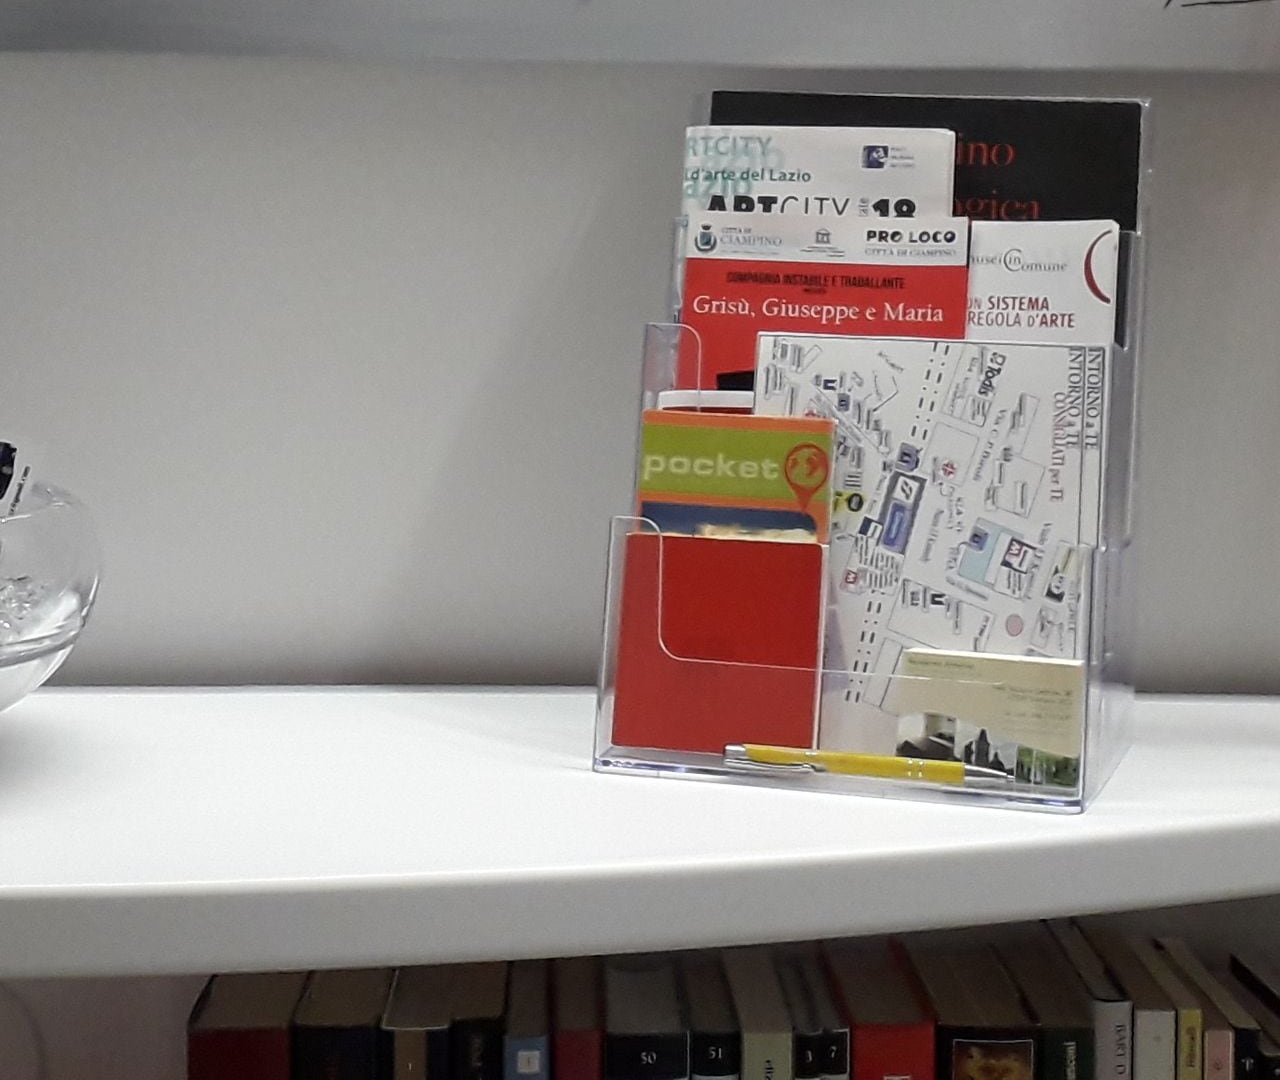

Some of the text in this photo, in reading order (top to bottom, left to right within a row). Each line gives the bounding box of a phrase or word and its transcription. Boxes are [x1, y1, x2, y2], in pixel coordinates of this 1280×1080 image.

[691, 168, 812, 182] d'arte del Lazio
[866, 230, 956, 243] PRO LOCO
[693, 294, 944, 325] Grisù, Giuseppe e Maria
[987, 296, 1050, 311] SISTEMA
[967, 311, 1022, 327] REGOLA
[1085, 346, 1102, 419] INTORNO
[643, 453, 781, 482] pocket
[640, 1051, 658, 1065] 50
[707, 1047, 723, 1060] 51
